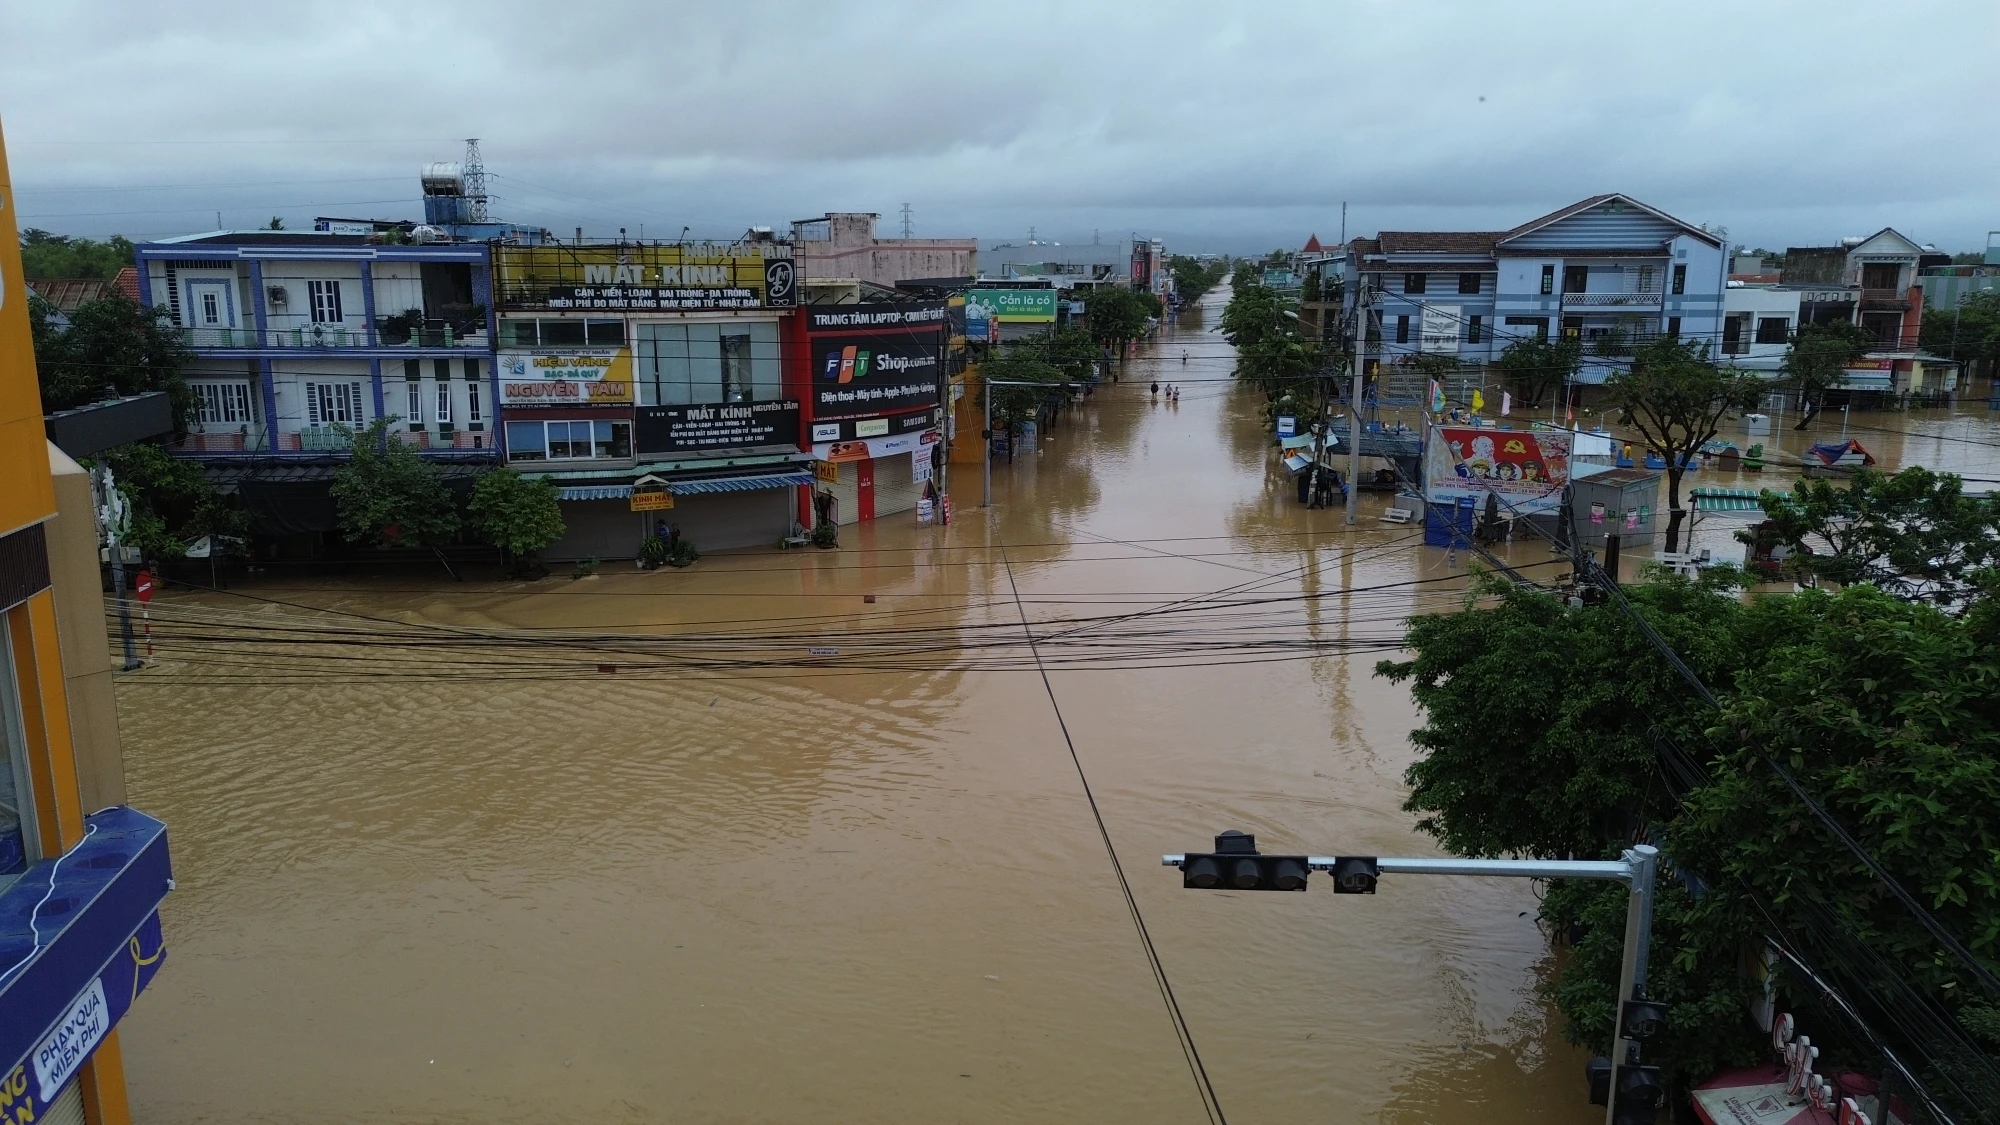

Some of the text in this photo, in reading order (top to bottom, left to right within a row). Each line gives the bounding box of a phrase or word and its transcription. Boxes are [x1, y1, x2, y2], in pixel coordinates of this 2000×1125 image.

[583, 255, 728, 284] MẮT KÍNH
[574, 288, 595, 298] CẬN
[602, 286, 622, 297] VIỄN
[628, 288, 652, 298] LOẠN
[659, 289, 674, 298] HAI
[723, 288, 750, 298] TRÒNG
[577, 298, 591, 308] PHÍ
[594, 299, 606, 308] ĐO
[608, 297, 629, 308] MẮT
[631, 297, 656, 308] BẰNG
[660, 298, 679, 308] MÁY
[682, 298, 702, 309] ĐIỆN
[744, 296, 760, 308] BẢN
[998, 294, 1050, 304] Cần là có
[814, 314, 848, 326] TRUNG
[850, 311, 870, 324] TÂM
[532, 356, 569, 369] HIỆU
[876, 353, 936, 374] Shop.com.vn
[581, 368, 600, 378] QUÝ
[585, 379, 626, 396] TÂM
[820, 391, 838, 404] Điện
[687, 404, 716, 420] MẮT
[720, 405, 752, 419] KÍNH
[752, 402, 782, 412] NGUYÊN
[782, 401, 798, 410] TÂM
[903, 416, 927, 428] SAMSUNG
[816, 428, 837, 436] ASUS
[40, 991, 100, 1068] PHẦN QUÀ
[50, 1012, 100, 1084] MIỄN PHÍ
